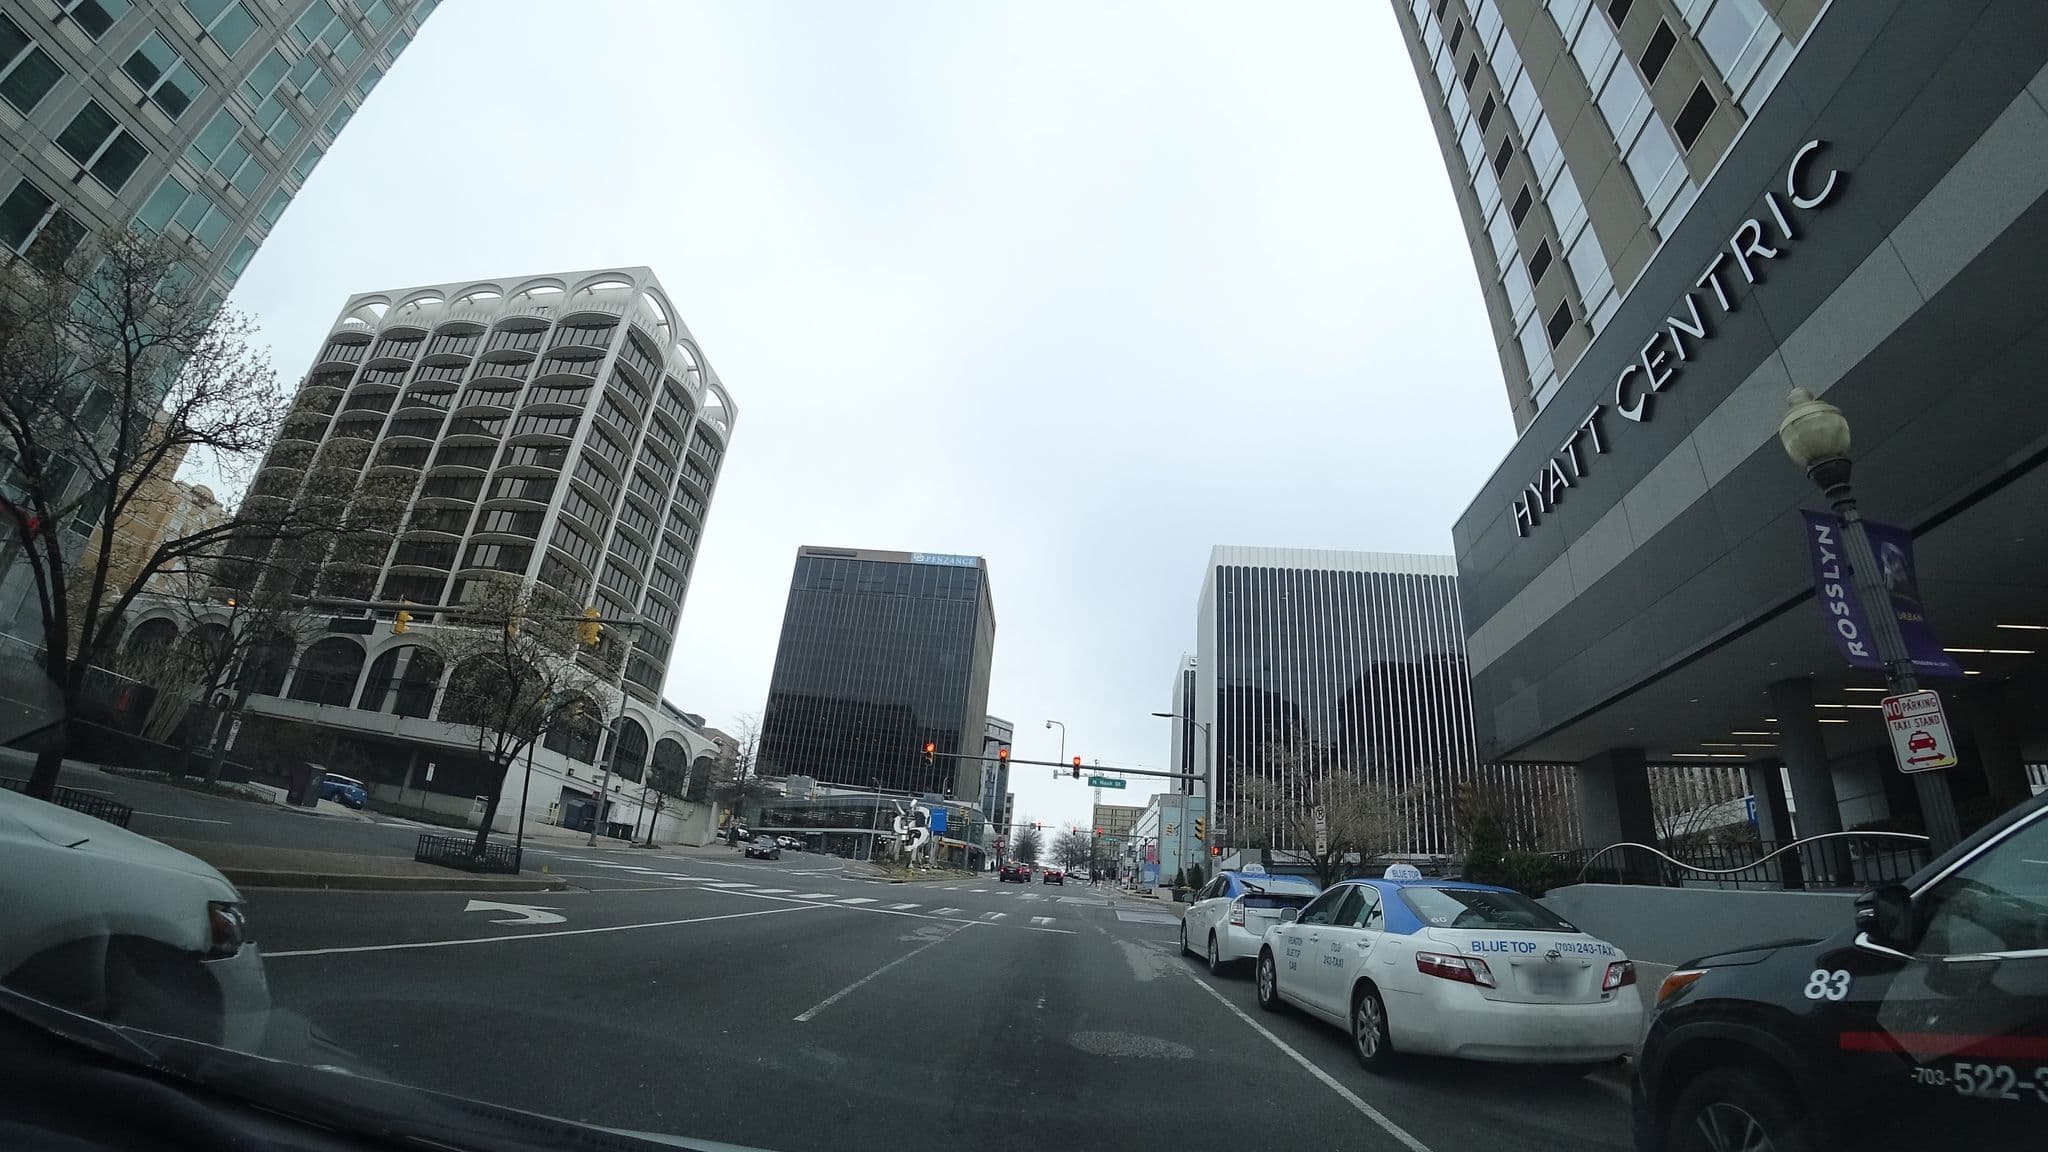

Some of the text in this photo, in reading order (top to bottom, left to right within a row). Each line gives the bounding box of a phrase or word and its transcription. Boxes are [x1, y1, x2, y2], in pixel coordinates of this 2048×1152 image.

[1513, 139, 1838, 537] HYATT CENTRIC
[926, 555, 975, 566] PENZANCE
[1815, 524, 1869, 657] ROSSLYN
[1884, 698, 1937, 718] NO PARKING
[1894, 715, 1940, 731] TAXI STAND
[1392, 869, 1419, 879] BLUE TOP
[1472, 940, 1537, 953] BLUE TOP
[1555, 941, 1616, 957] (703) 243-TAXI
[1804, 969, 1850, 1001] 83
